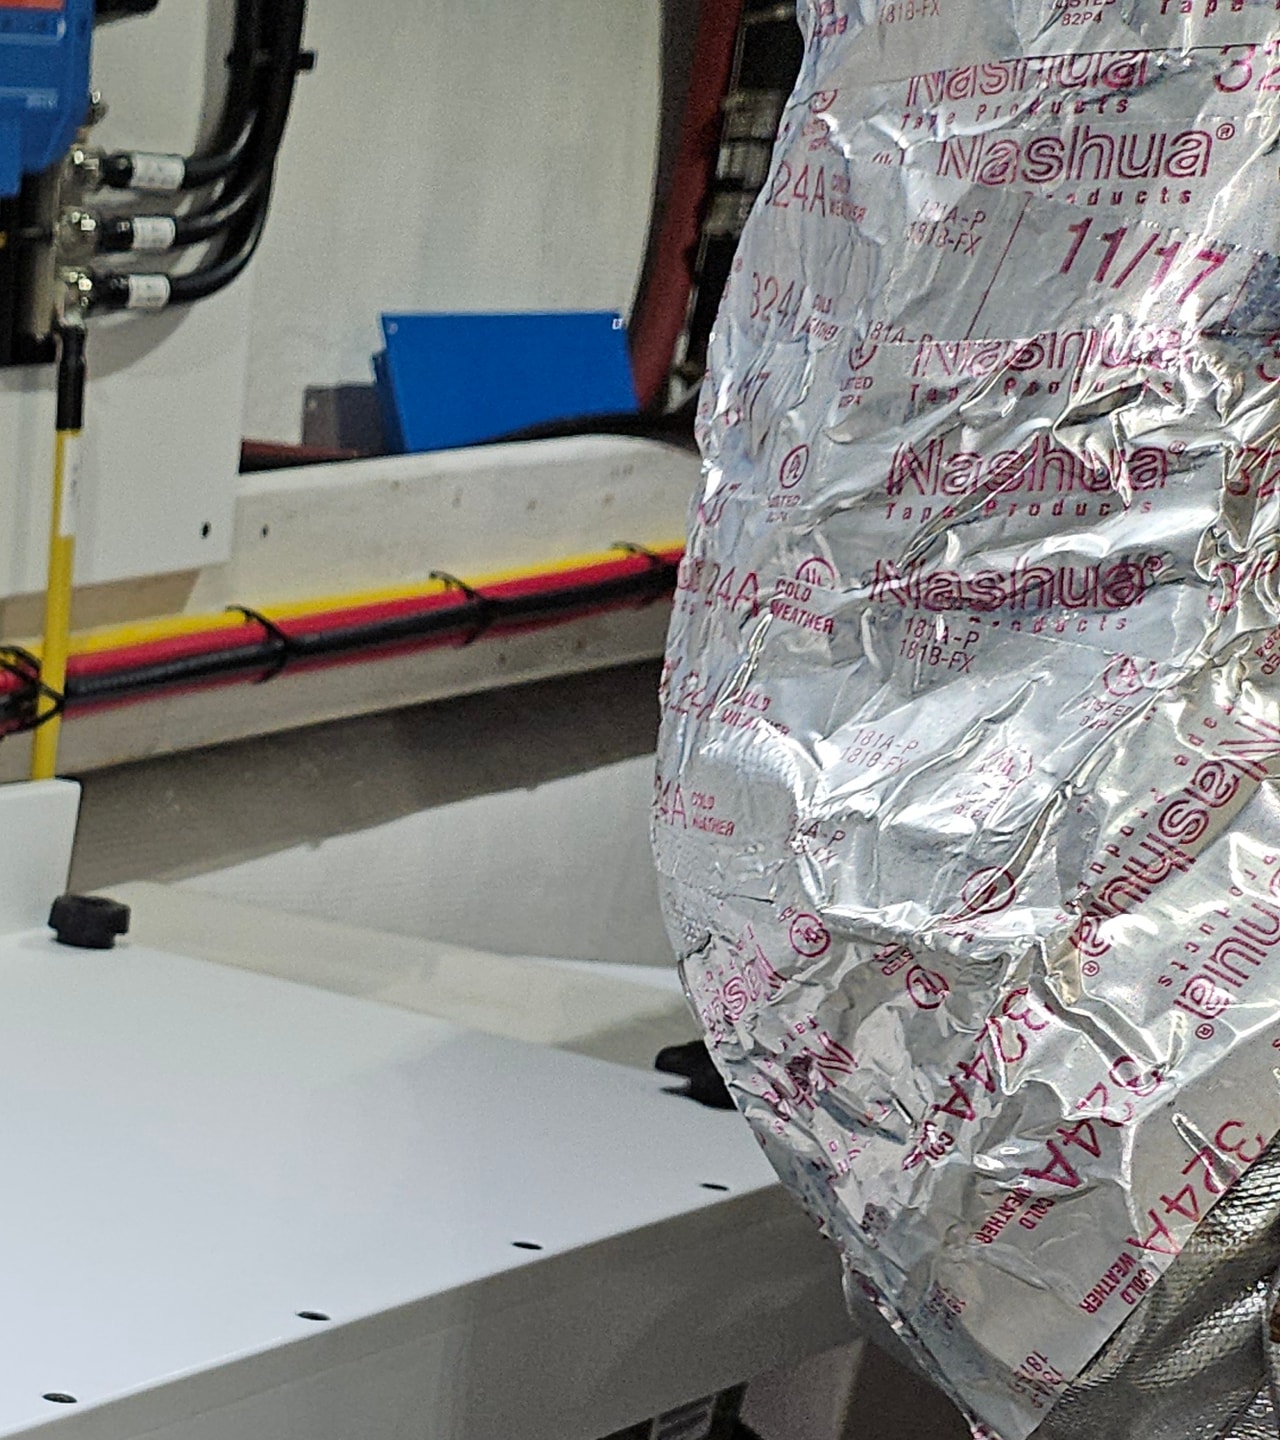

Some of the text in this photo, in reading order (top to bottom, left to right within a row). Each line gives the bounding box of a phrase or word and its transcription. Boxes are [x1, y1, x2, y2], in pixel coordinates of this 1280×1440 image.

[1061, 11, 1103, 26] 82P4
[1059, 216, 1230, 305] 11/17
[775, 578, 812, 602] COLD
[770, 600, 835, 634] WEATHER
[899, 638, 977, 673] 181B-FX
[854, 729, 919, 752] 181A-P
[1125, 1119, 1266, 1256] 324A
[975, 1186, 1035, 1245] WEATHER
[1018, 1196, 1056, 1231] COLD
[1078, 1252, 1138, 1315] WEATHER
[1119, 1267, 1155, 1306] COLD
